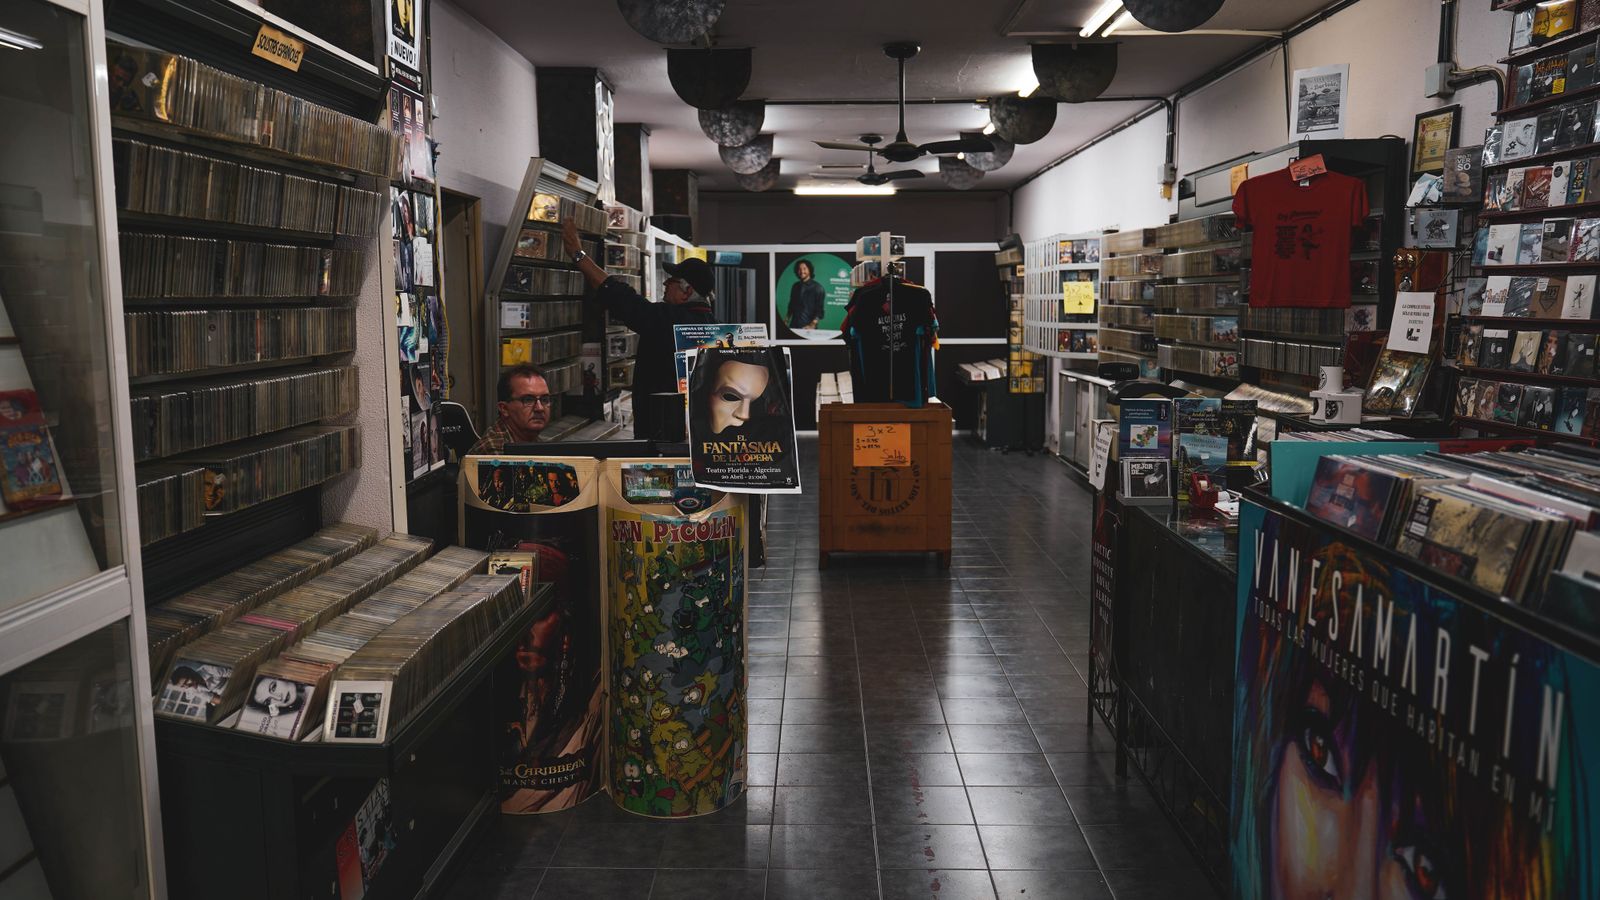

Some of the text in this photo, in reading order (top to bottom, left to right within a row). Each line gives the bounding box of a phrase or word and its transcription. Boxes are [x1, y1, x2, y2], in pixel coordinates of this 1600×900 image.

[1456, 163, 1472, 171] SO
[703, 441, 782, 454] FANTASMA
[713, 454, 727, 463] DE
[729, 454, 741, 463] LA
[1254, 596, 1283, 632] TODAS
[1287, 619, 1306, 649] LAS
[1311, 637, 1365, 692] MUJERES
[1372, 680, 1399, 716] QUE
[1406, 703, 1481, 777] HABITAN
[1491, 764, 1516, 804] EN
[514, 758, 587, 779] CARIBBEAN
[503, 773, 576, 786] MAN'S CHEST
